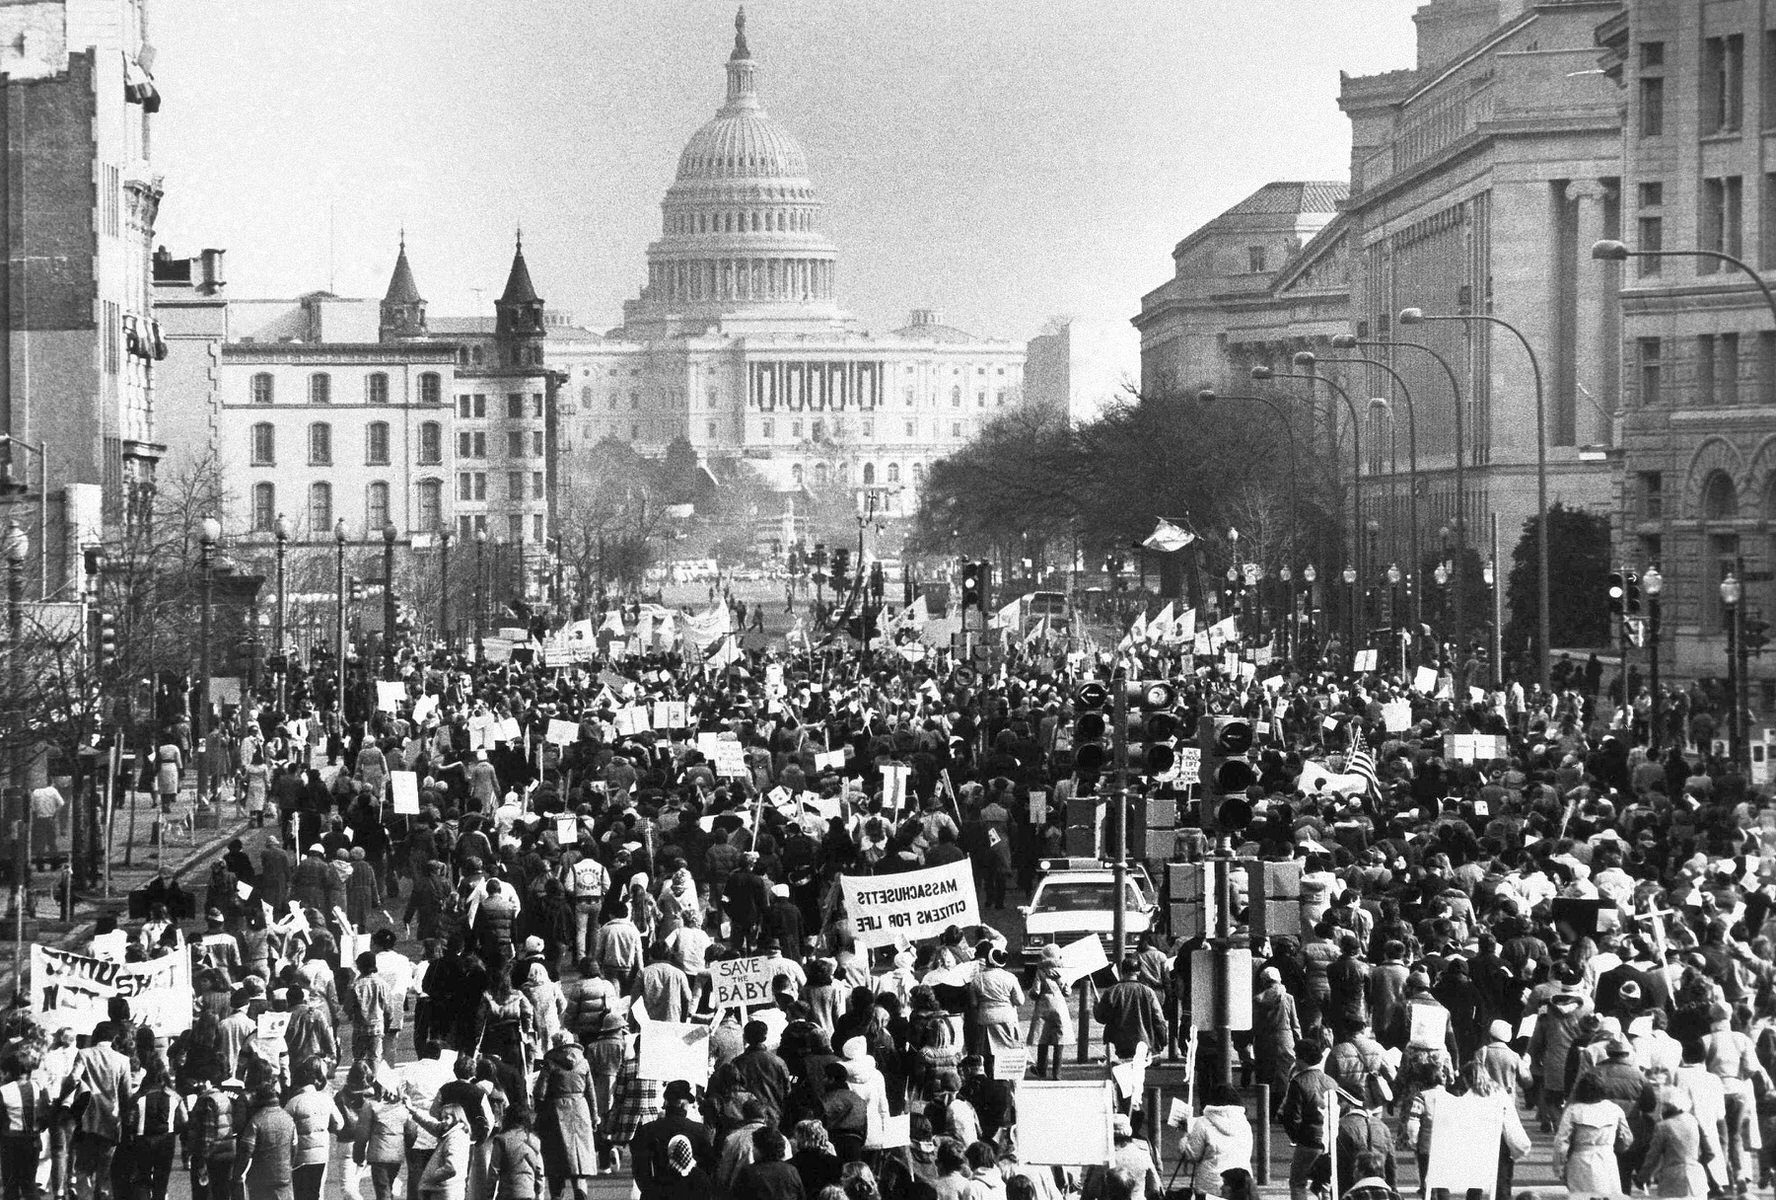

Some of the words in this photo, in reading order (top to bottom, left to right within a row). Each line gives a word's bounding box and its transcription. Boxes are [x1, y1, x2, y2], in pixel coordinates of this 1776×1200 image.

[720, 958, 760, 977] SAVE
[731, 975, 748, 983] THE
[718, 980, 769, 1003] BABY
